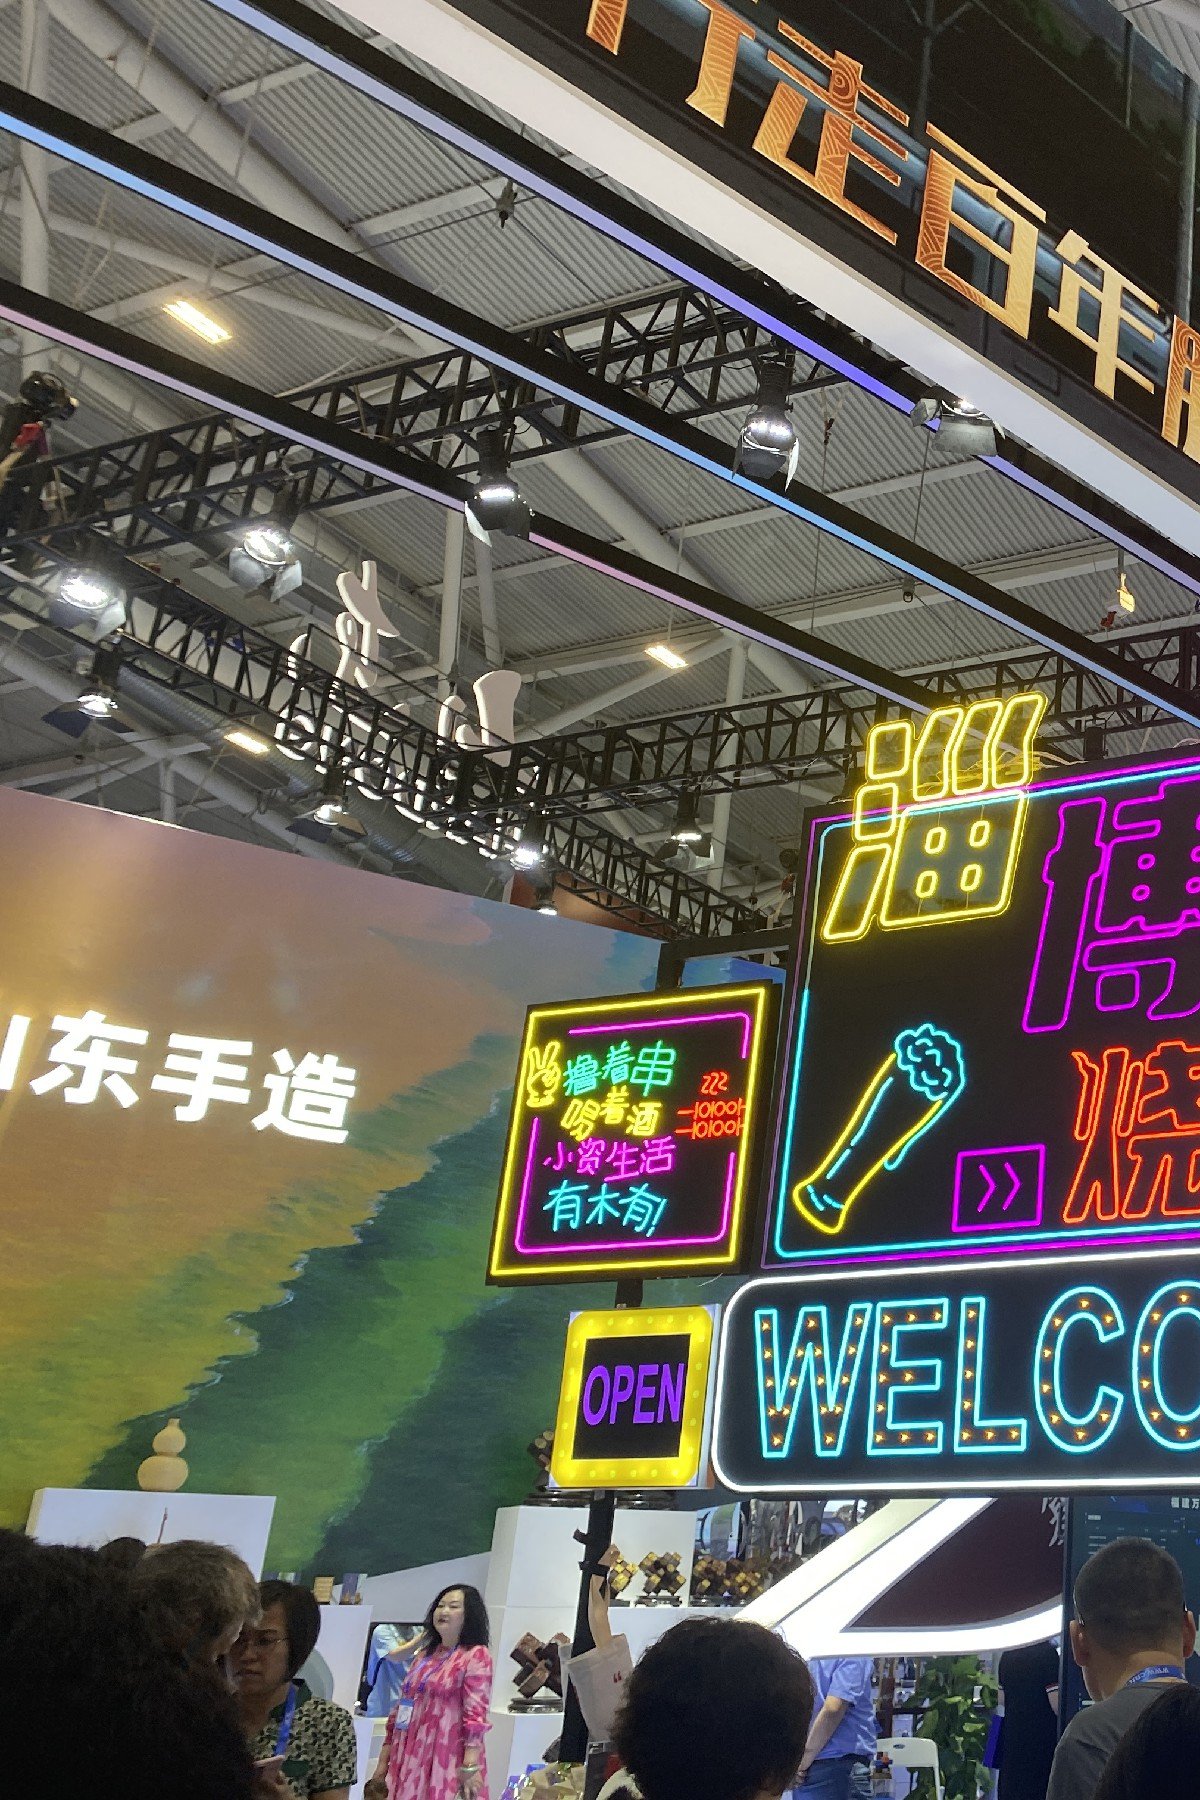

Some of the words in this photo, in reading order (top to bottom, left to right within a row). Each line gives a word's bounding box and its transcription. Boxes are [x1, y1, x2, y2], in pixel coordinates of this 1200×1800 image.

[0, 1010, 357, 1143] 东手造
[563, 1040, 676, 1097] 撸着串
[561, 1085, 662, 1141] 喝着酒
[543, 1134, 676, 1182] 小资生活
[583, 1363, 686, 1426] OPEN
